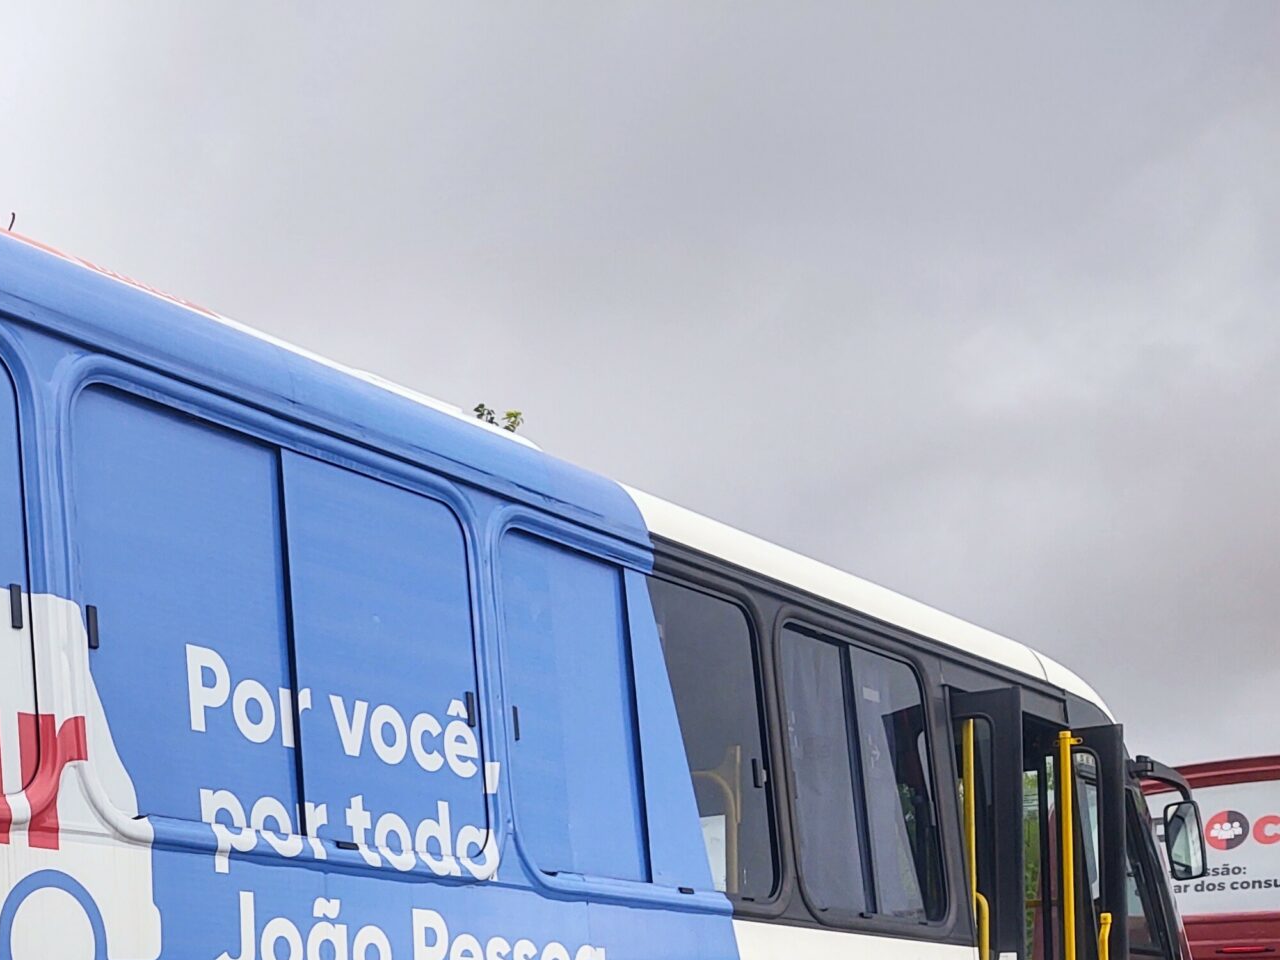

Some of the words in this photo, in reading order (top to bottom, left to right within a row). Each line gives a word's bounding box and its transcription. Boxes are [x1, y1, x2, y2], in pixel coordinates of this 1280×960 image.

[185, 643, 312, 748] Por
[329, 693, 501, 794] você,
[200, 788, 327, 873] por
[345, 794, 500, 882] toda
[1194, 880, 1226, 893] dos
